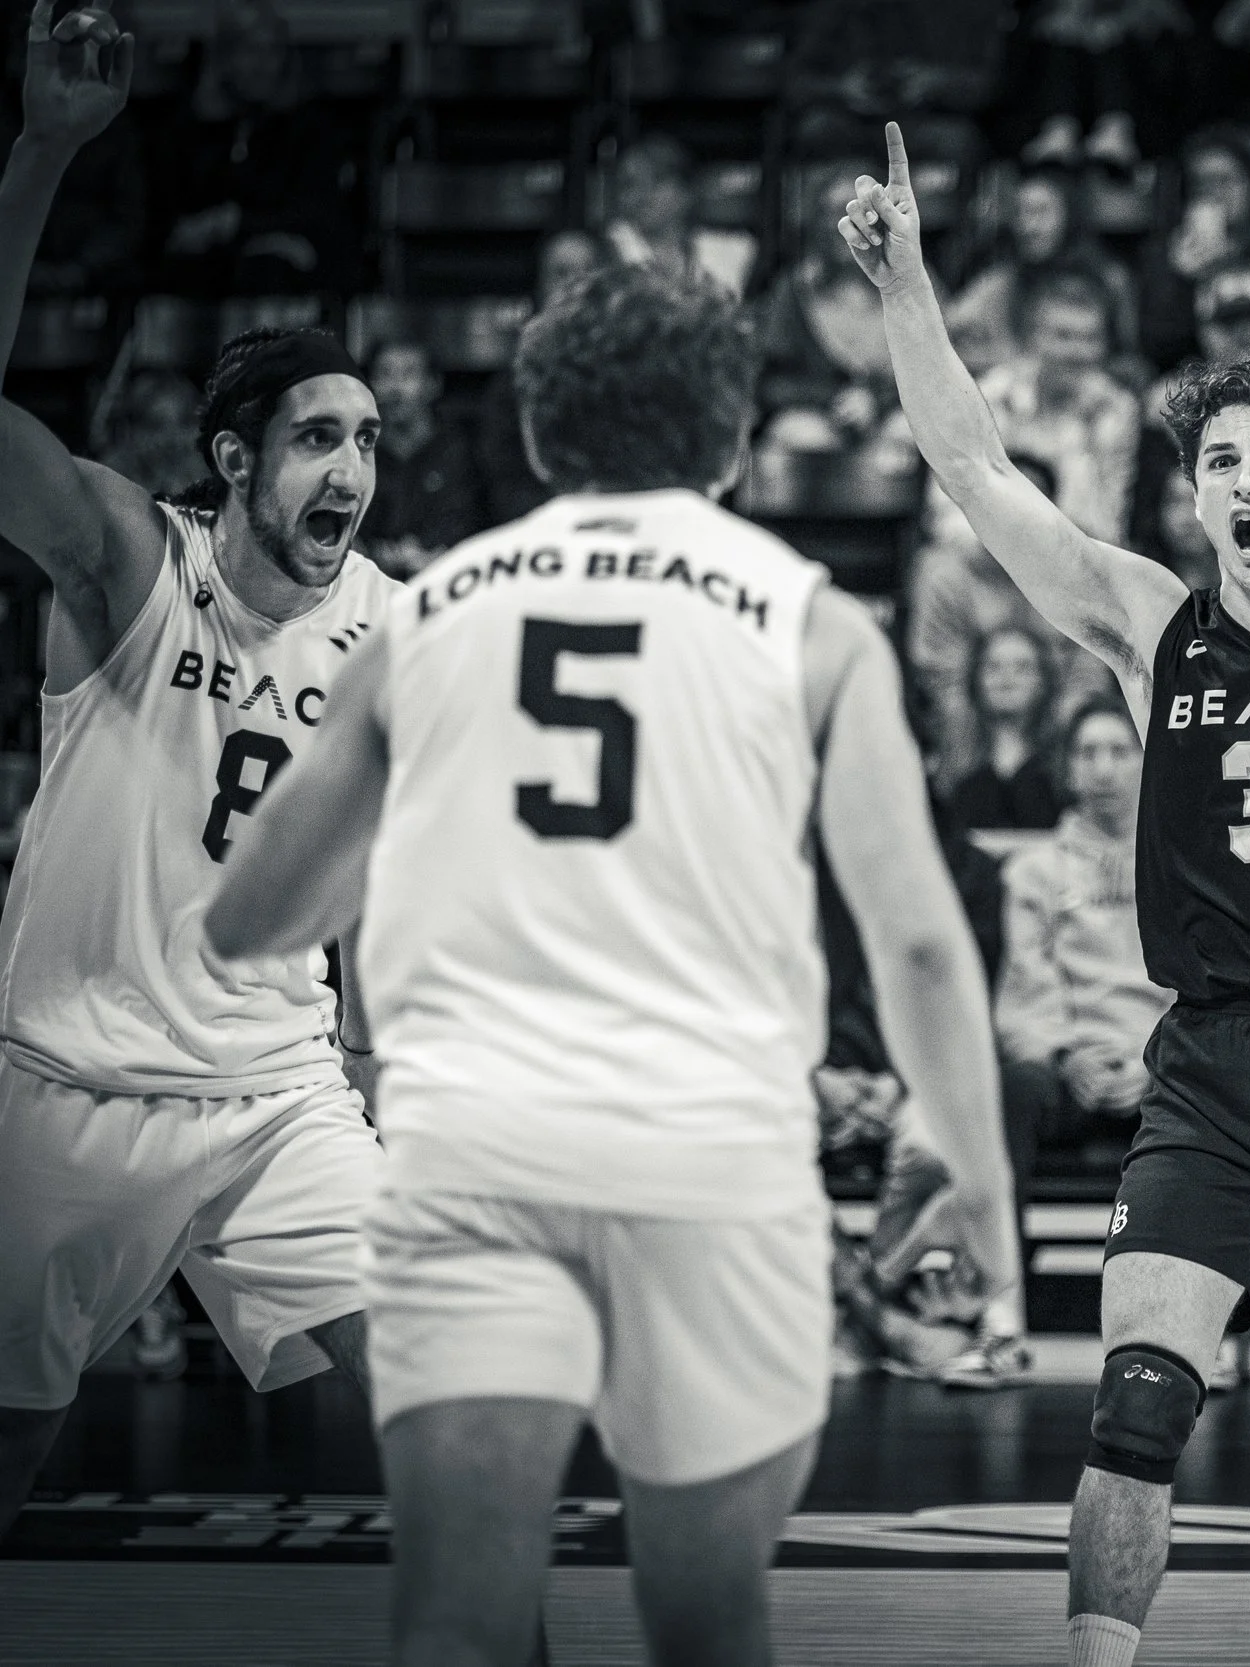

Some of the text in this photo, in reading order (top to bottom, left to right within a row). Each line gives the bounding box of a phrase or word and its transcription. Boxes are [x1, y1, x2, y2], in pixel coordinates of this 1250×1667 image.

[417, 548, 769, 630] LONG BEACH
[170, 650, 327, 727] BEAC
[515, 615, 643, 842] 5
[202, 728, 293, 864] 8
